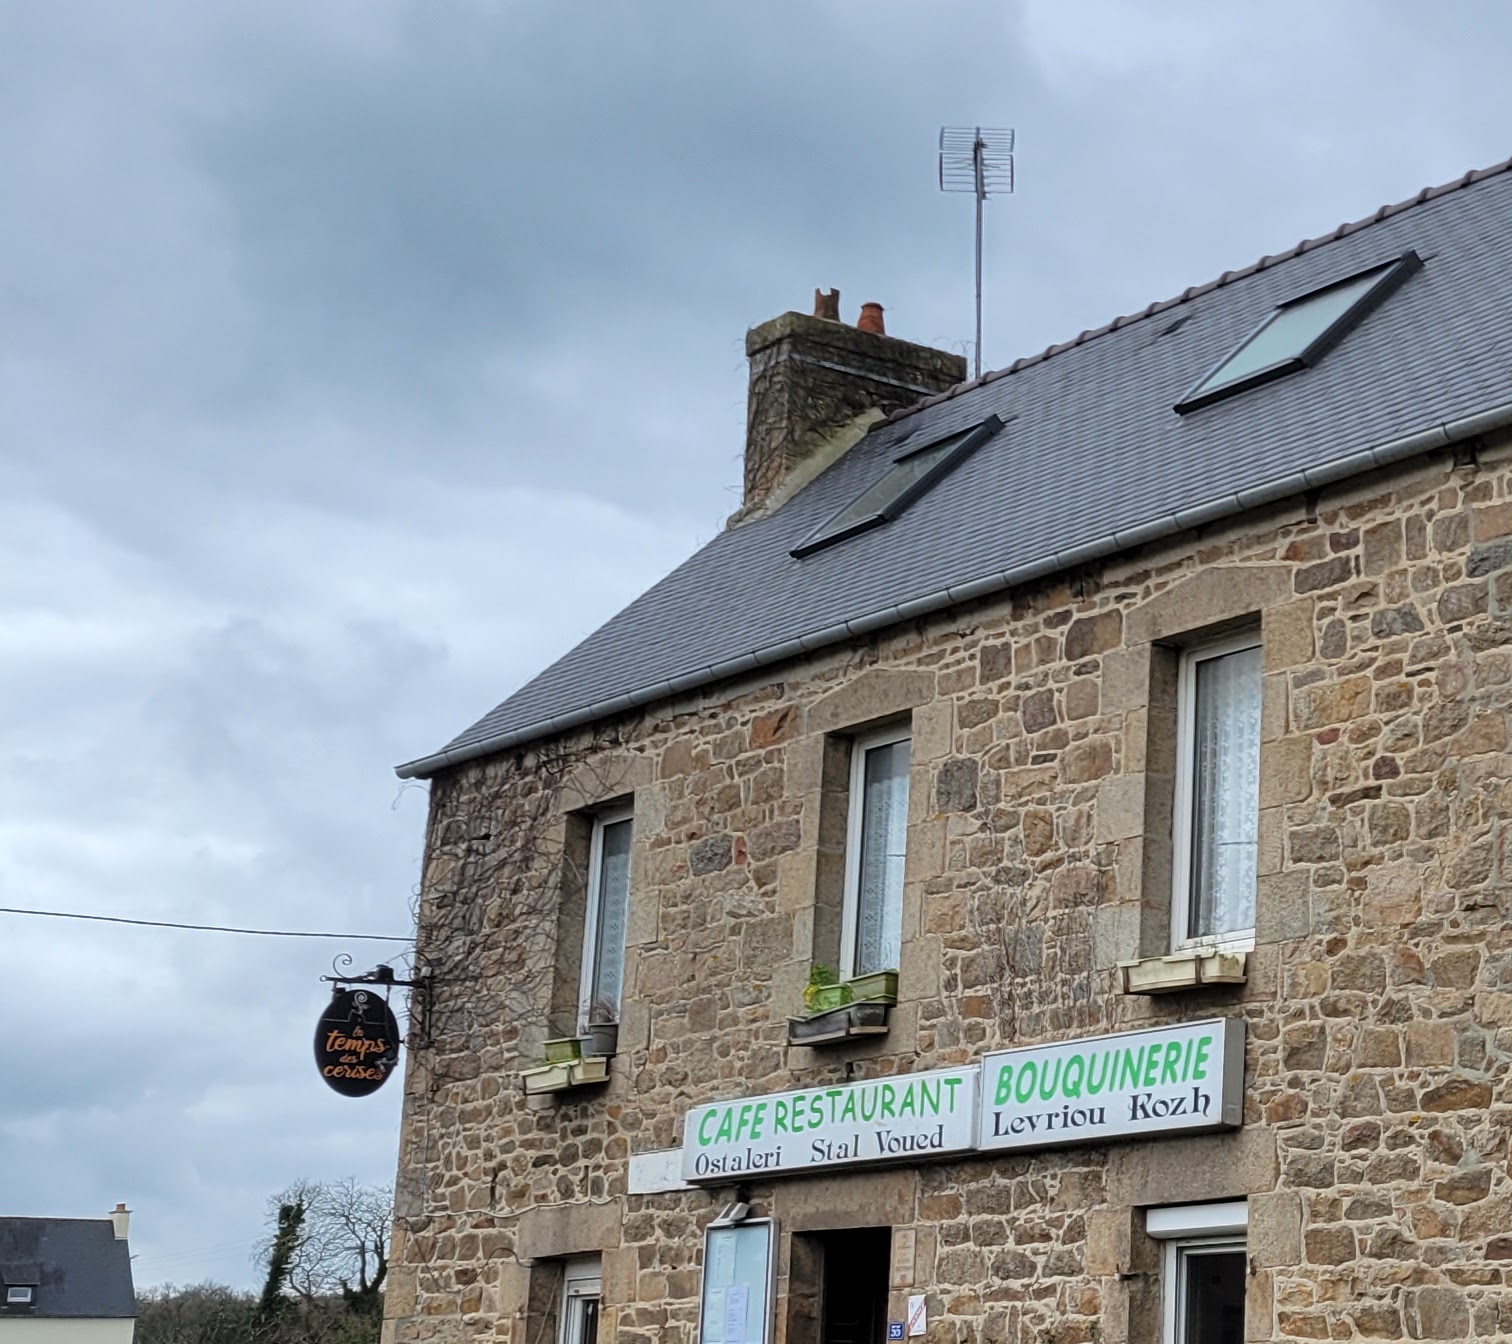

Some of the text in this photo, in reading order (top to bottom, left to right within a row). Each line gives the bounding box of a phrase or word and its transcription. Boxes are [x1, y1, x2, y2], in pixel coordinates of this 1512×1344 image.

[326, 1029, 387, 1061] temps
[339, 1053, 359, 1064] des
[994, 1036, 1212, 1105] BOUQUINERIE
[323, 1065, 384, 1080] cerises
[698, 1078, 963, 1147] CAFE RESTAURANT
[992, 1086, 1212, 1137] Levriou Kozh
[695, 1124, 944, 1175] Ostaleri Stal Voued
